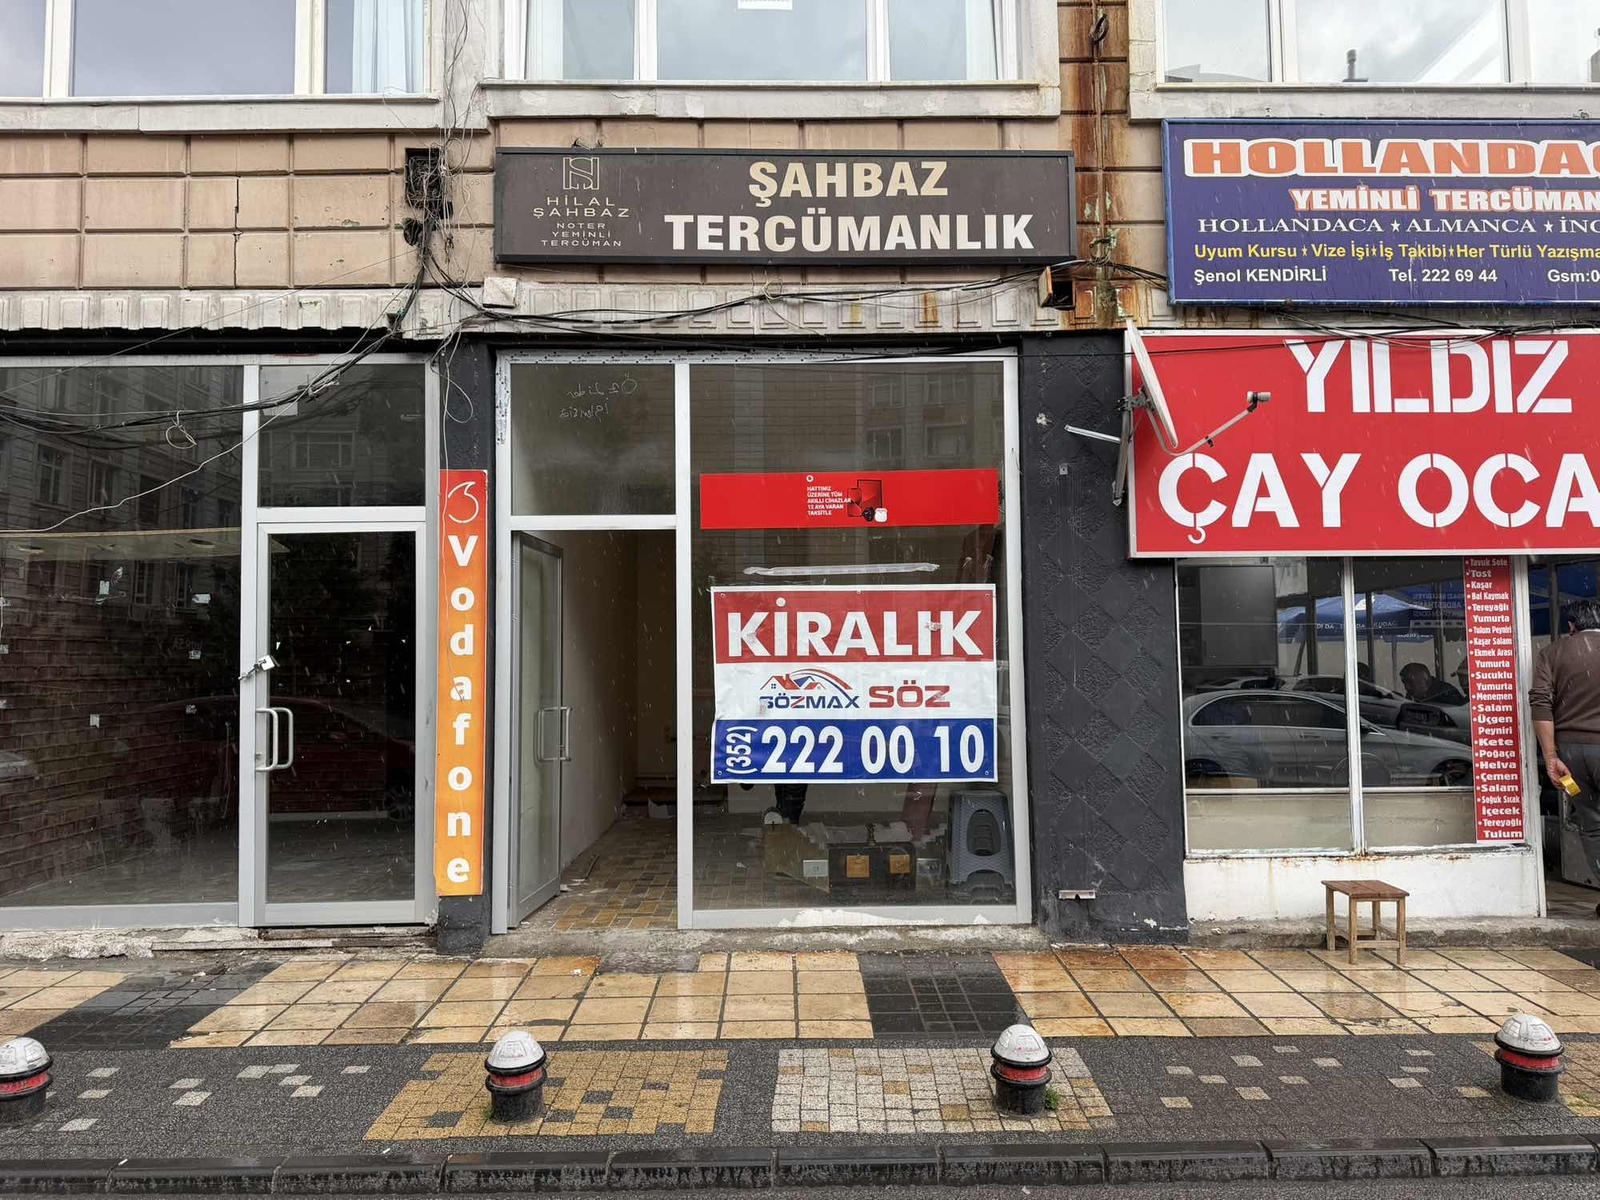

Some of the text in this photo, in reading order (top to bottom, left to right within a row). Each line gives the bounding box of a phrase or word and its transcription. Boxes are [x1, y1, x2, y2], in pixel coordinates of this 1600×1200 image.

[748, 160, 948, 207] ŞAHBAZ
[547, 195, 615, 206] HİLAL
[1289, 185, 1420, 212] YEMİNLİ
[533, 207, 629, 219] ŞAHBAZ
[664, 207, 1034, 252] TERCÜMANLIK
[1198, 218, 1384, 233] HOLLANDACA
[1406, 218, 1537, 233] ALMANCA
[552, 230, 611, 238] YEMİNLİ
[541, 237, 621, 247] TERCÜMAN
[1195, 243, 1243, 261] Uyum
[1247, 243, 1297, 258] Kursu
[1311, 243, 1346, 257] Vize
[1351, 240, 1370, 260] İşi
[1379, 240, 1394, 260] İş
[1398, 243, 1446, 258] Takibi
[1456, 244, 1485, 258] Her
[1489, 244, 1532, 258] Türlü
[1194, 265, 1327, 286] Şenol KENDİRLİ
[1389, 269, 1498, 282] Tel. 222 69 44
[1284, 339, 1573, 413] YILDIZ
[1158, 452, 1600, 544] ÇAY OCA
[1471, 570, 1492, 578] Tost
[1471, 581, 1493, 591] Kaşar
[1472, 592, 1483, 600] Bal
[1483, 592, 1509, 601] Kaymak
[1472, 603, 1509, 613] Tereyağlı
[1473, 614, 1510, 622] Yumurta
[728, 597, 983, 657] KİRALIK
[1473, 637, 1512, 646] Kaşar Salam
[1475, 660, 1511, 668] Yumurta
[1475, 671, 1513, 679] Sucuklu
[1476, 682, 1513, 690] Yumurta
[869, 679, 950, 708] SÖZ
[1476, 692, 1513, 700] Menemen
[759, 692, 860, 709] SÖZMAX
[447, 534, 479, 884] Vodafone
[1477, 704, 1513, 712] Salam
[1477, 714, 1513, 725] Üçgen
[1478, 726, 1513, 736] Peyniri
[1478, 738, 1514, 747] Kete
[725, 725, 758, 774] (352)
[761, 725, 984, 774] 222 00 10
[1479, 749, 1516, 759] Poğaça
[1480, 761, 1517, 769] Helva
[1480, 773, 1518, 782] Çemen
[1481, 784, 1519, 792] Salam
[1481, 795, 1502, 804] Soğuk
[1482, 805, 1520, 816] İçecek
[1482, 818, 1522, 828] Tereyağlı
[1483, 830, 1523, 838] Tulum
